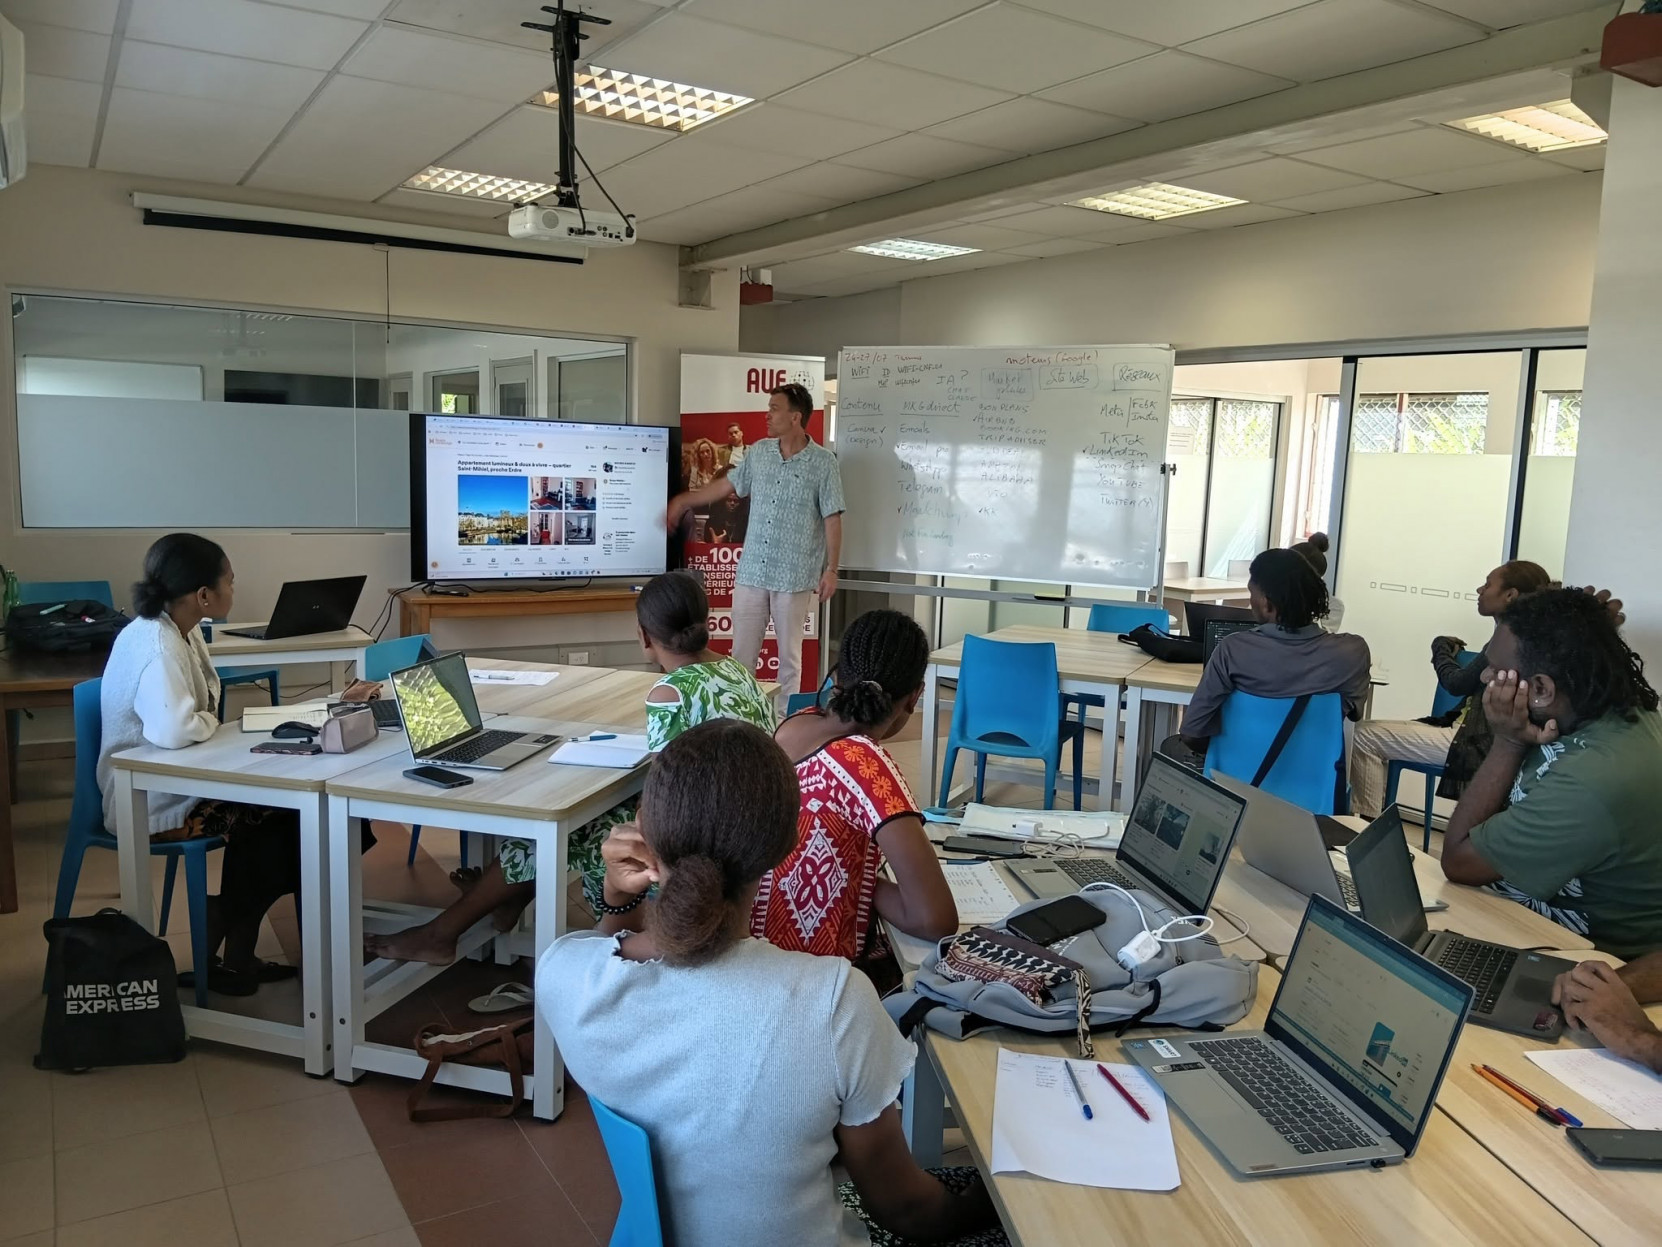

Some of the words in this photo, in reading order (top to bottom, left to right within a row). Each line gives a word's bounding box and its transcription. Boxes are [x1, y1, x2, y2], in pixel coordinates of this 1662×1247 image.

[936, 375, 955, 386] IA
[960, 369, 969, 380] ?
[1069, 370, 1091, 384] Web
[1100, 403, 1124, 418] Meta
[695, 555, 709, 563] DE
[64, 979, 158, 999] MERCAN
[66, 995, 160, 1014] EXPRESS
